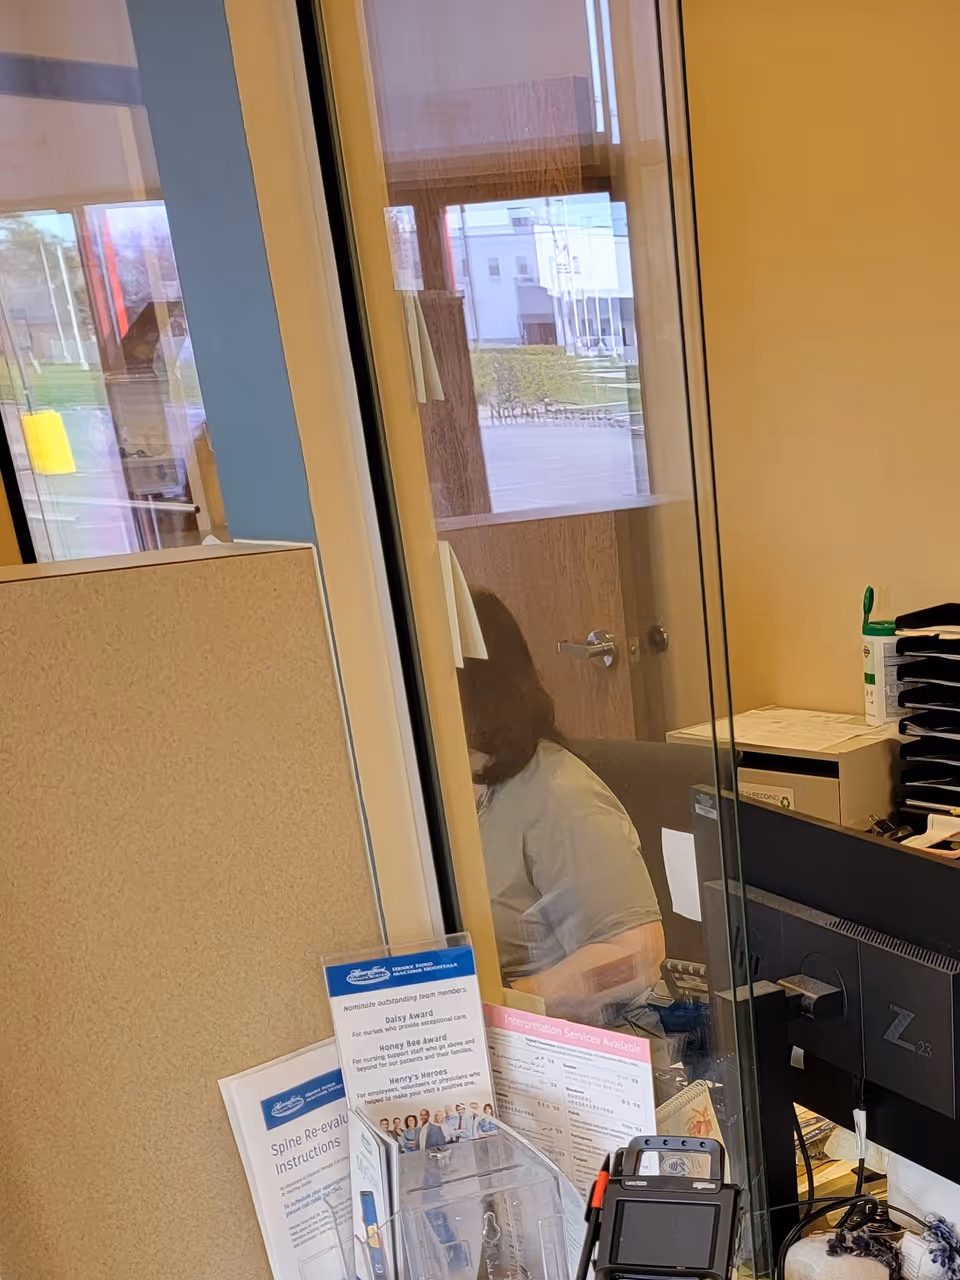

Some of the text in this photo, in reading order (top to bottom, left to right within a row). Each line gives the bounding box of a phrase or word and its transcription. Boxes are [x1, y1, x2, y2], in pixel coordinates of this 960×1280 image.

[344, 1002, 376, 1012] Nominate
[378, 995, 417, 1007] outstanding
[385, 1010, 433, 1024] Daisy Award
[399, 1021, 419, 1031] provide
[421, 1016, 452, 1026] exceptional
[504, 1013, 563, 1036] Interpretation
[564, 1029, 602, 1045] Services
[603, 1037, 641, 1054] Available
[883, 1003, 916, 1052] Z
[379, 1034, 447, 1052] Honey Bee Award
[363, 1053, 385, 1063] nursing
[387, 1050, 409, 1059] support
[410, 1046, 424, 1055] staff
[356, 1063, 378, 1072] beyond
[400, 1055, 423, 1065] patients
[389, 1068, 447, 1085] Henry's Heroes
[400, 1081, 430, 1090] volunteers
[439, 1074, 468, 1084] physicians
[441, 1082, 463, 1091] positive
[271, 1136, 302, 1157] Spine
[275, 1138, 341, 1175] Instructions
